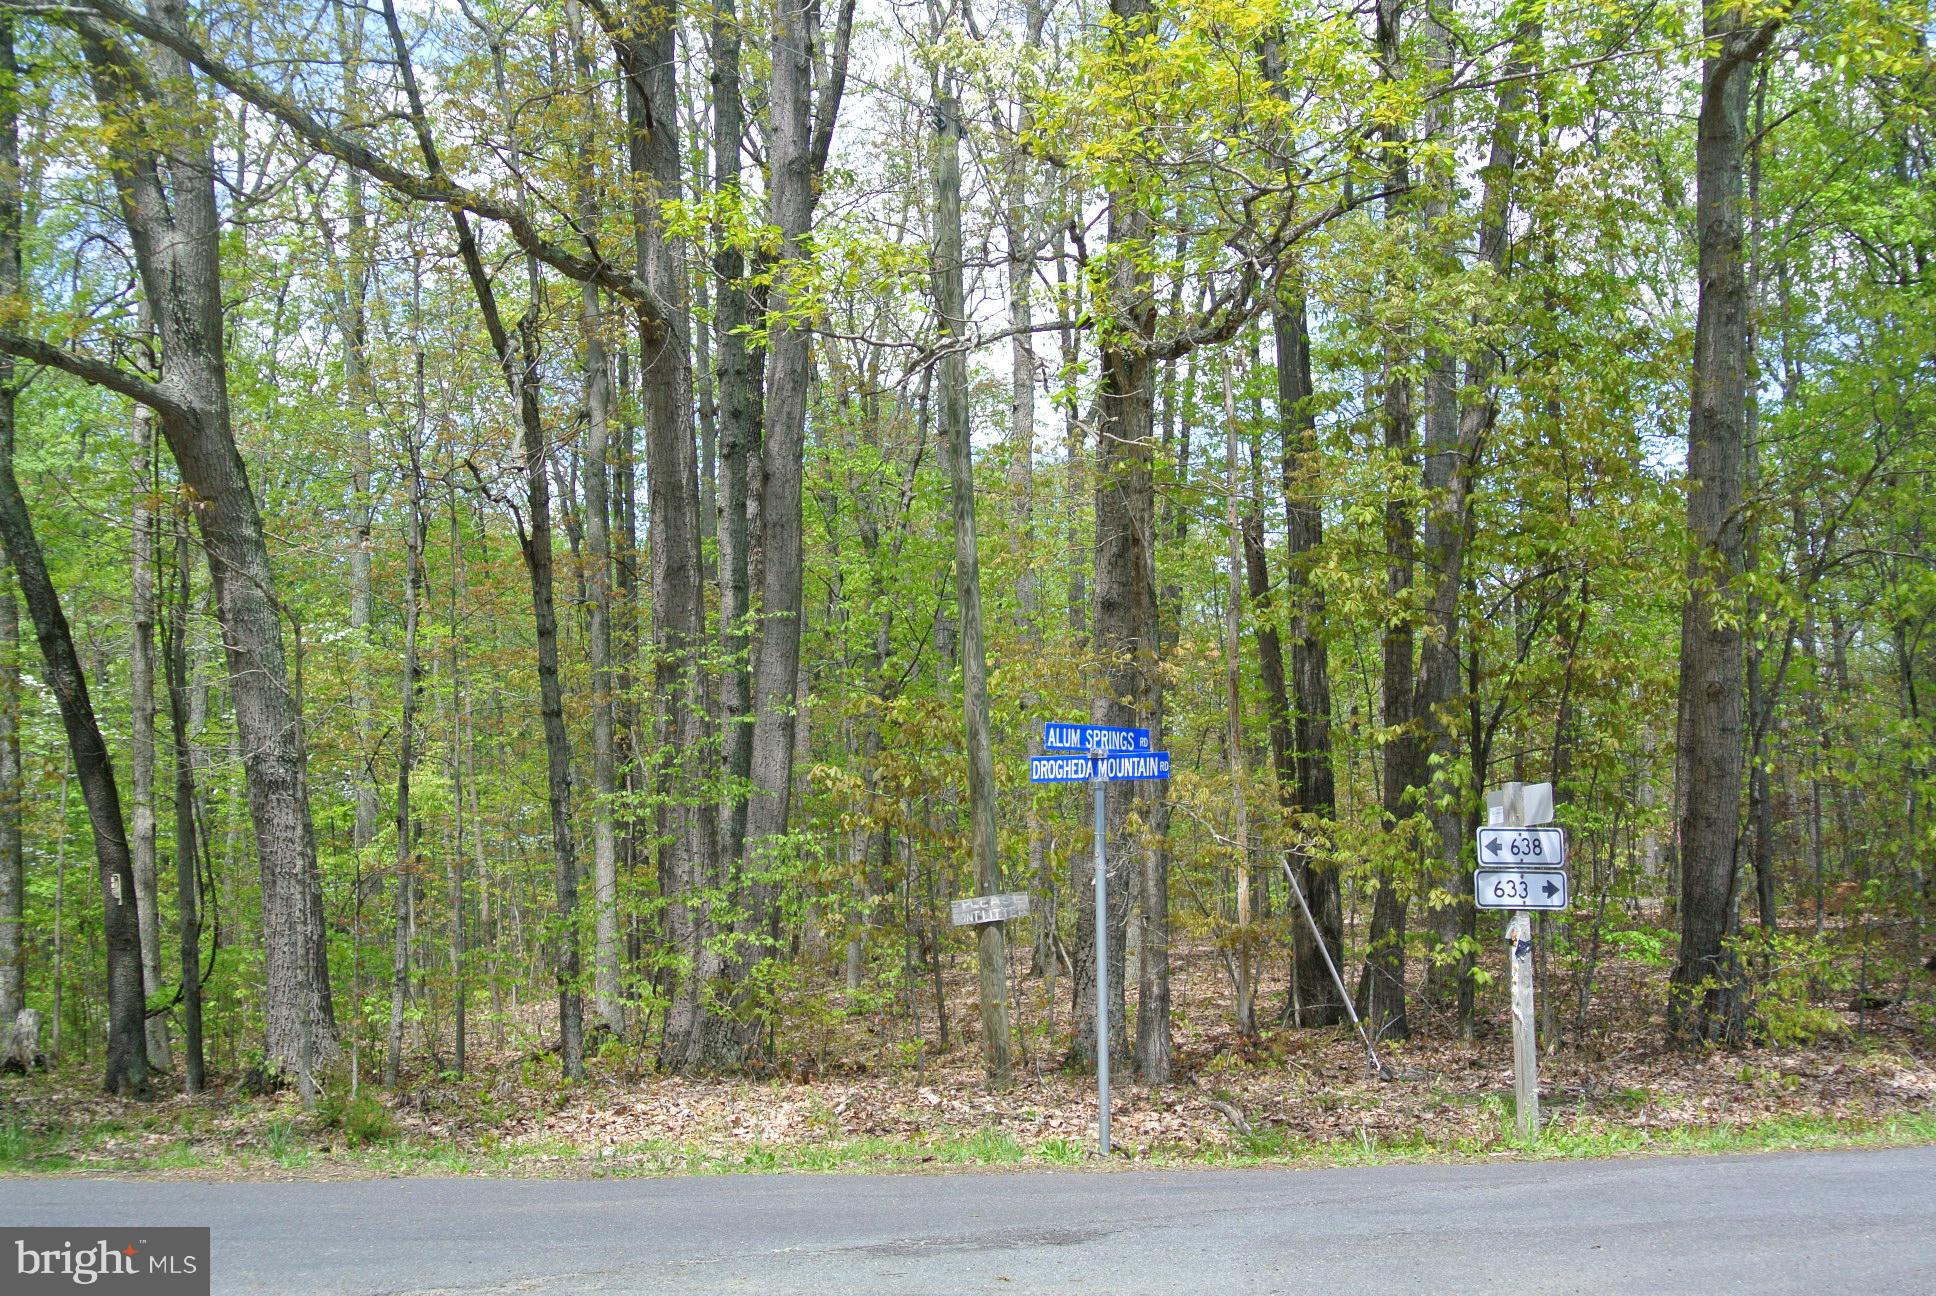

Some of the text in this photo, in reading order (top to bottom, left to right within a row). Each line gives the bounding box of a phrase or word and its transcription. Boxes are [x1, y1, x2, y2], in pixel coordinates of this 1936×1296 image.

[1047, 727, 1148, 750] ALUM SPRINGS RD
[1032, 757, 1169, 779] DROGHEDA MOUNTAIN RD
[1510, 837, 1542, 856] 638
[1493, 879, 1528, 899] 633
